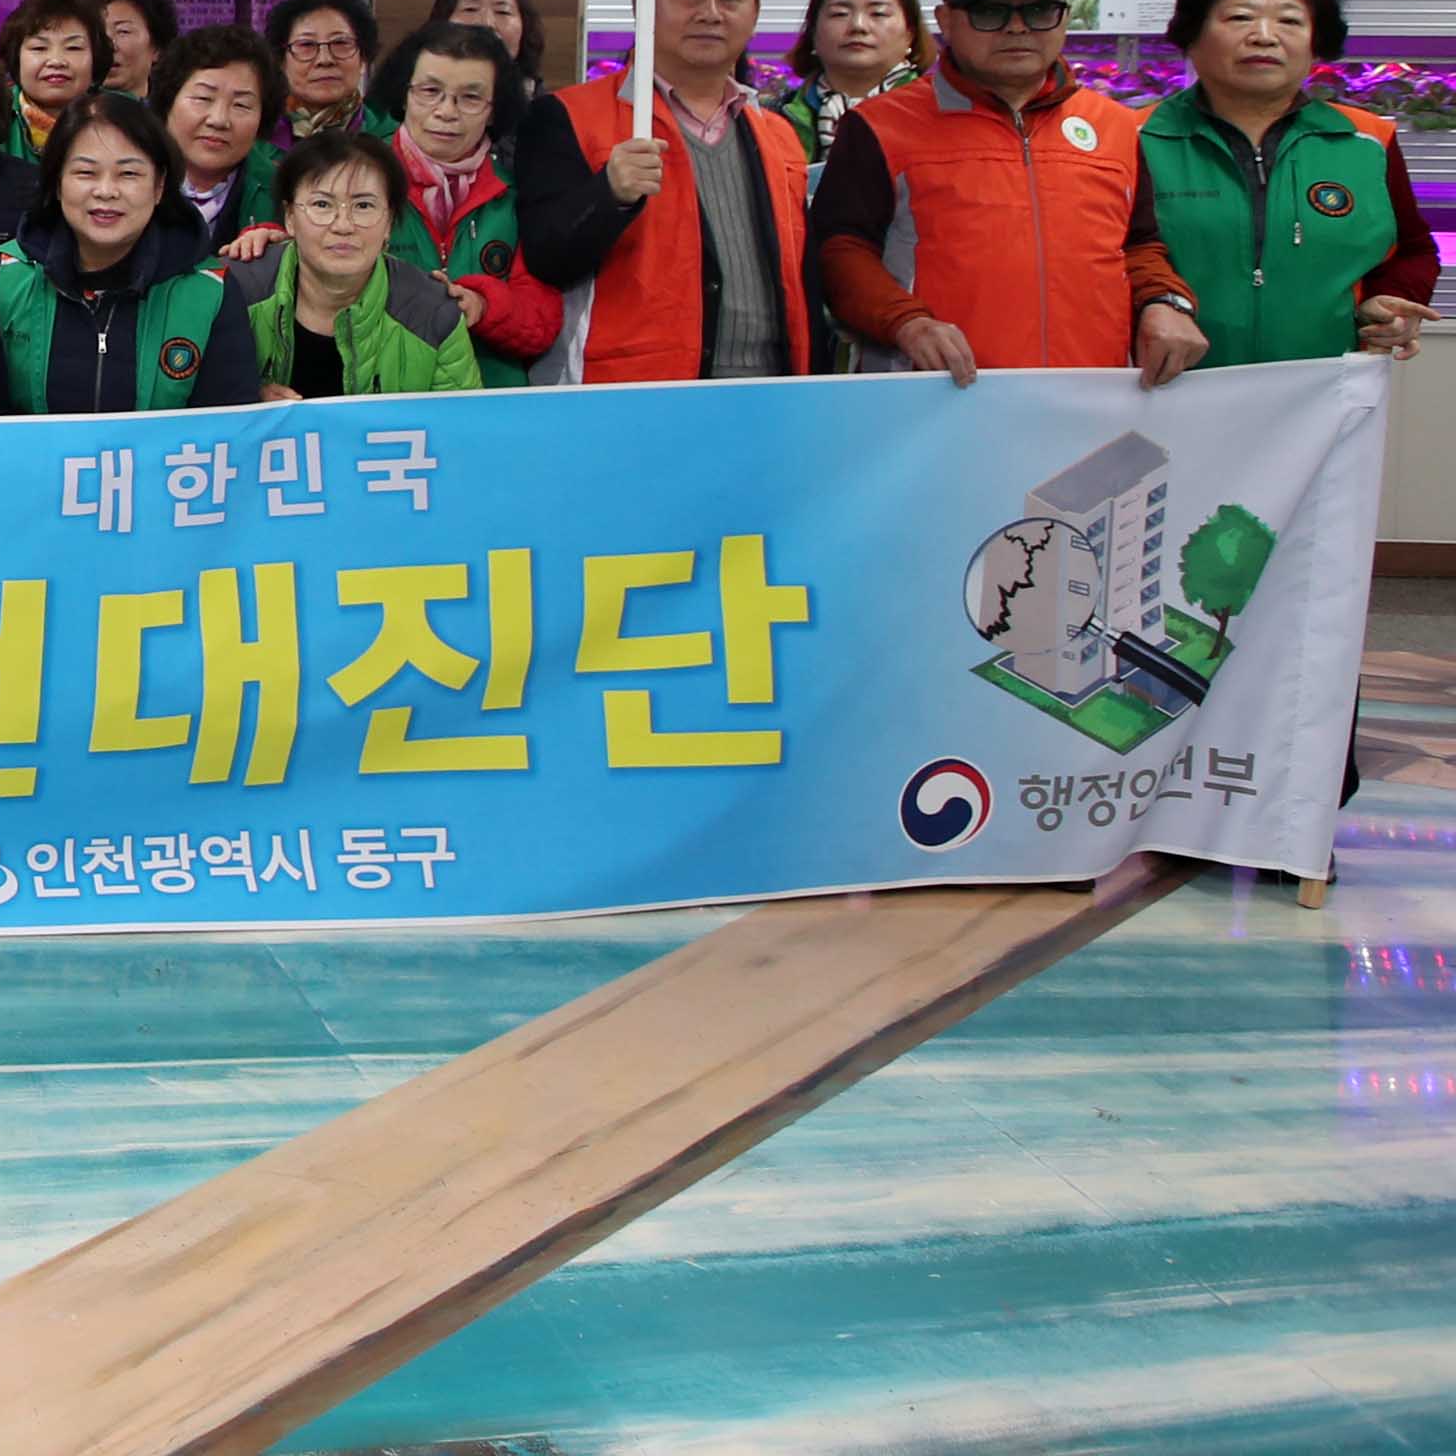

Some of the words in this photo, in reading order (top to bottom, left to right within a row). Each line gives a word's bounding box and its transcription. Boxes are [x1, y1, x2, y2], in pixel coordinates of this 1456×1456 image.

[61, 429, 437, 533] 대한민국
[26, 828, 317, 897] 인천광역시
[336, 826, 455, 890] 동구
